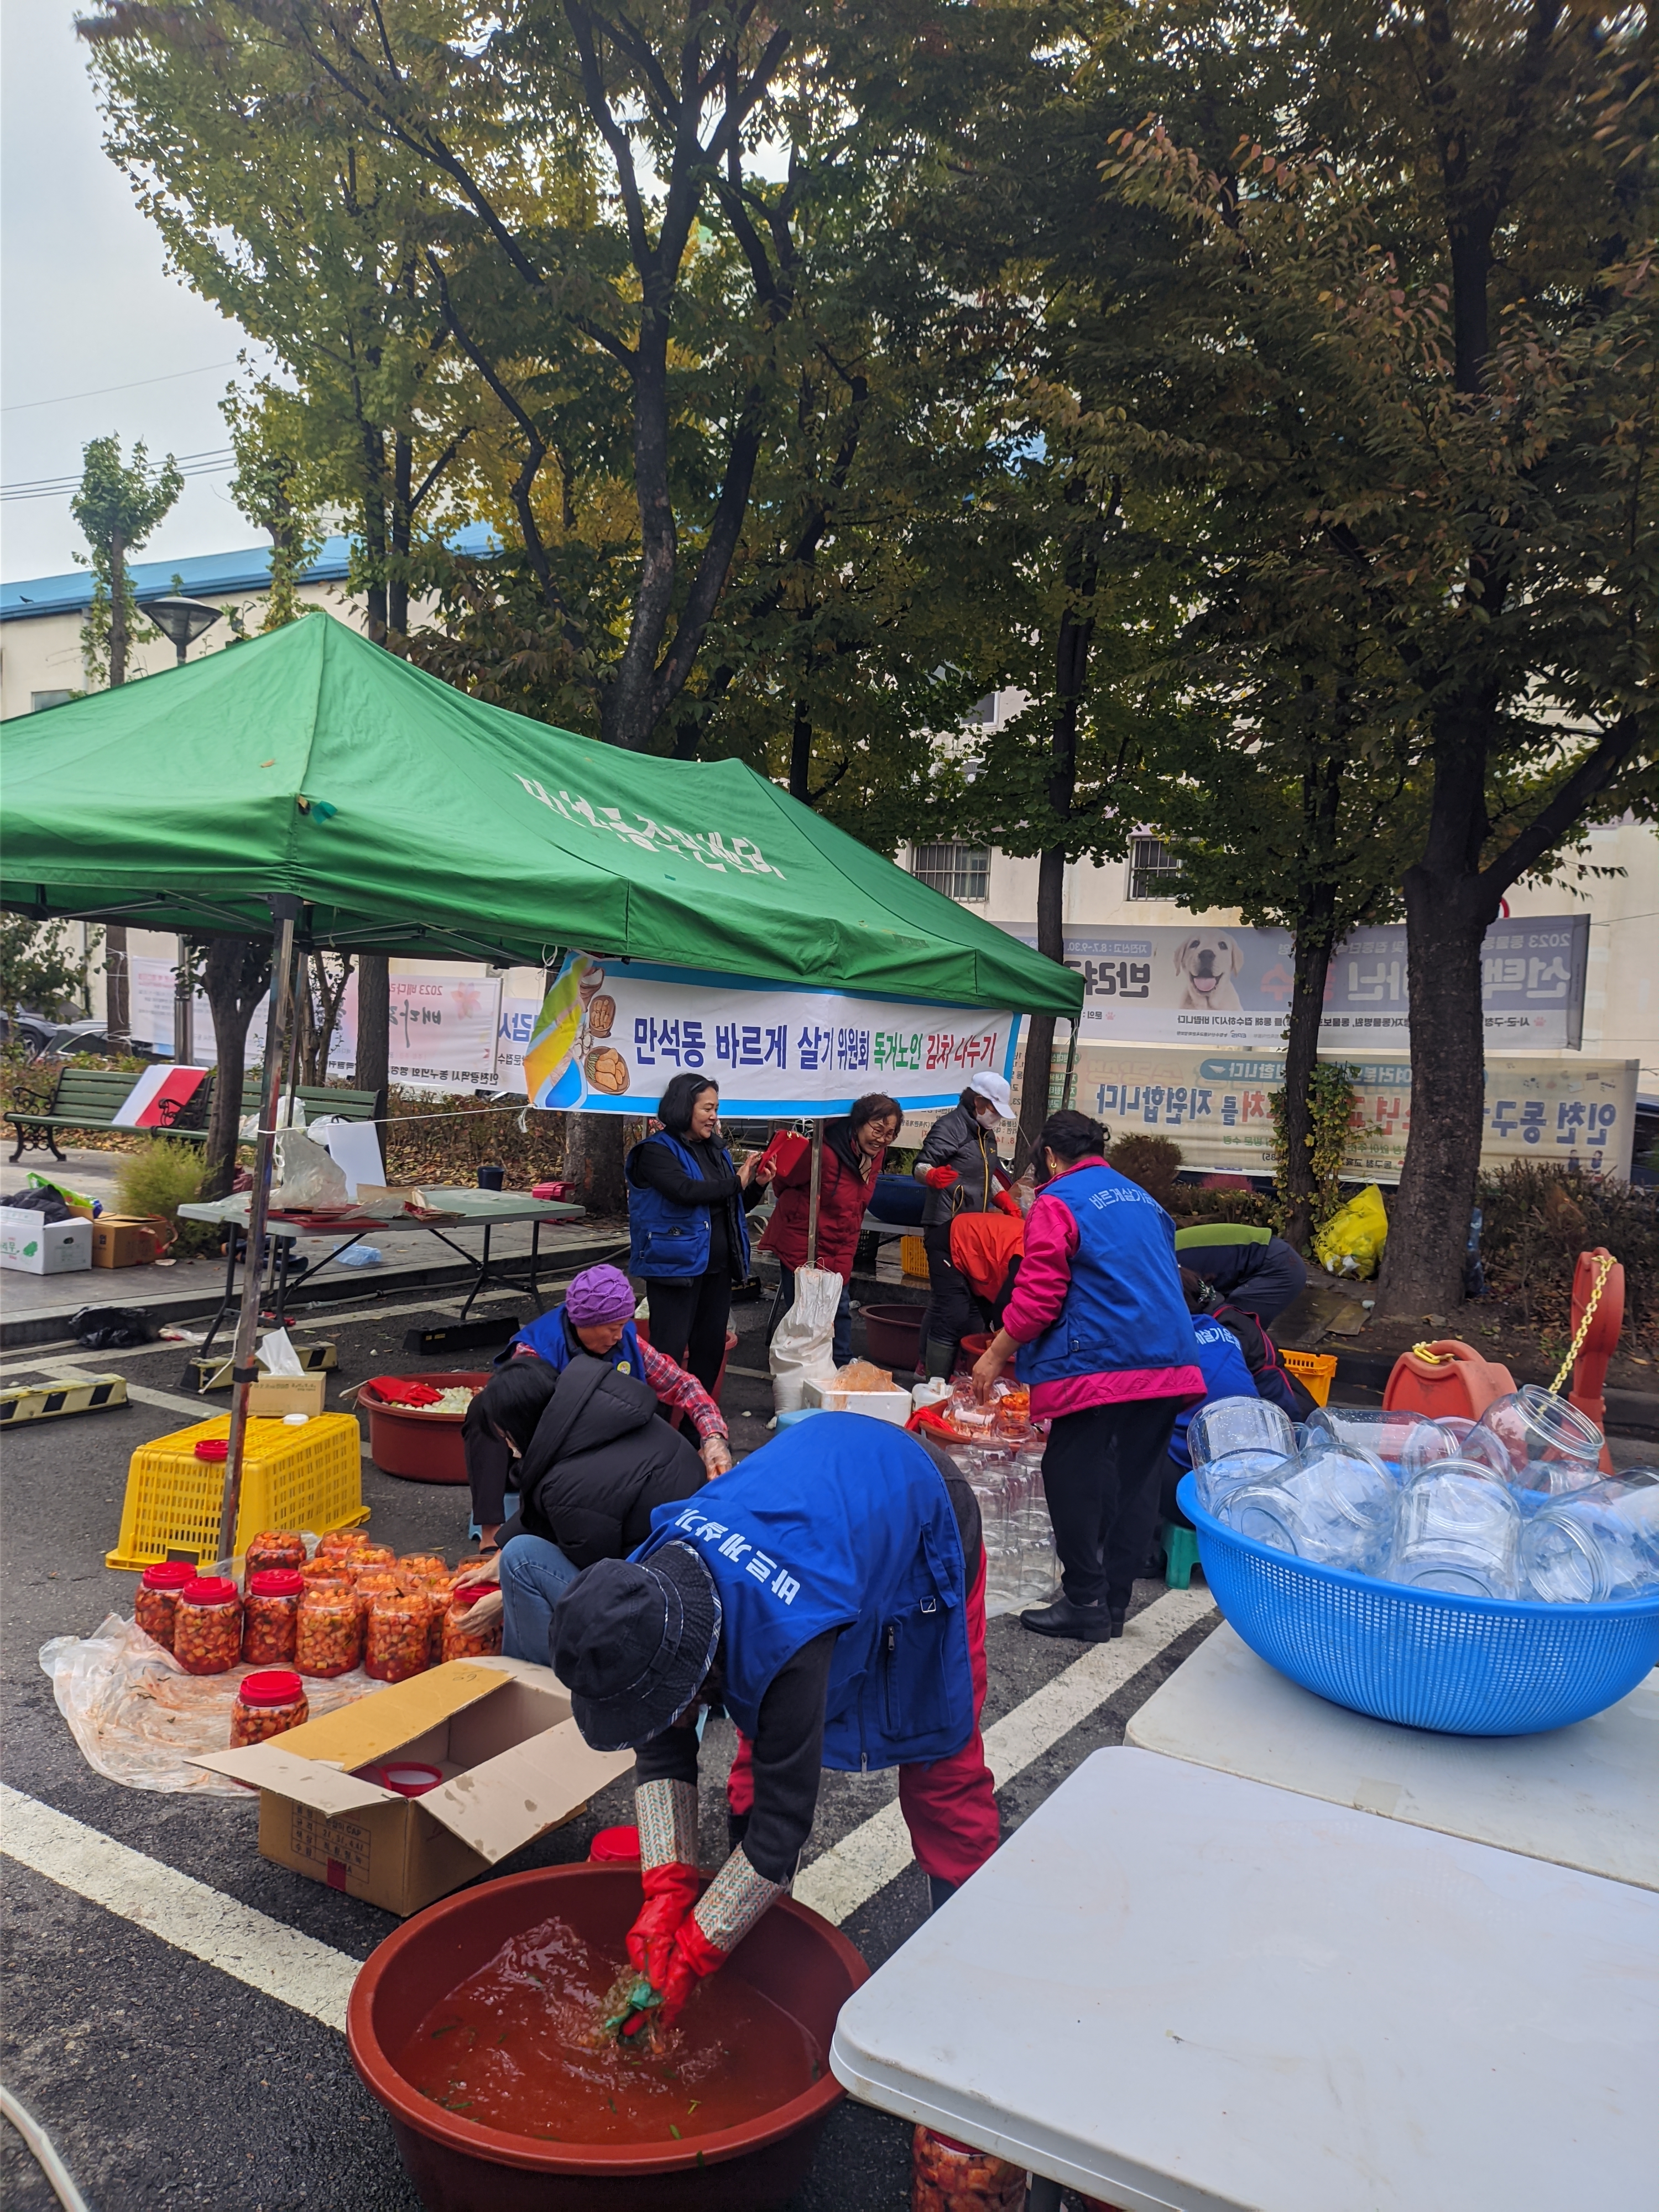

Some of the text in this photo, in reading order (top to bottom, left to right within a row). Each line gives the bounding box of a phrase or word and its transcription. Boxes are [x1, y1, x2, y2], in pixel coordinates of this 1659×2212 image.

[633, 1016, 706, 1068] 만석동
[716, 1021, 787, 1070] 바르게
[837, 1026, 869, 1072] 위원회
[873, 1032, 922, 1072] 독거노인
[926, 1032, 953, 1071] 김치
[954, 1031, 997, 1069] 나누기
[346, 1825, 362, 1836] CAP
